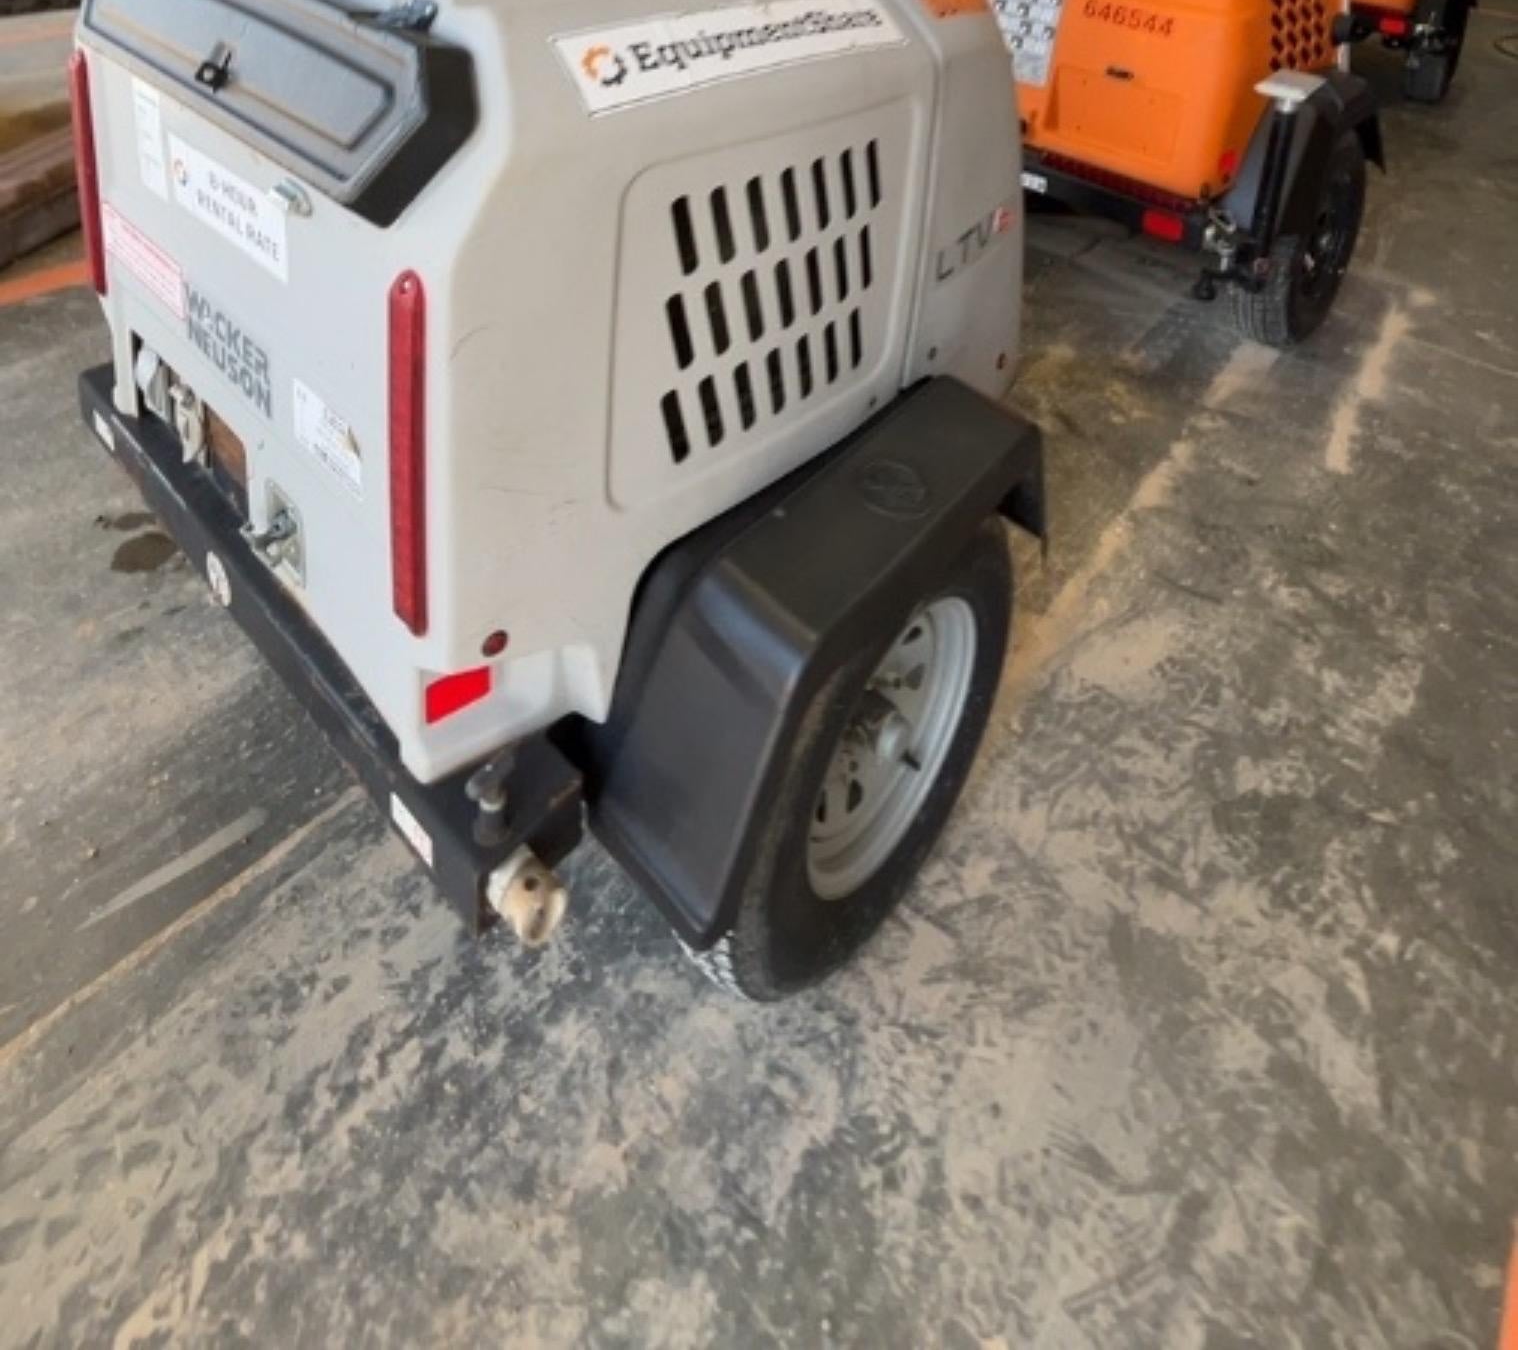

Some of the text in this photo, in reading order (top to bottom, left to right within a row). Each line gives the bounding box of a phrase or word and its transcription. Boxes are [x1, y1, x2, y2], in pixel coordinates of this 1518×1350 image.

[628, 9, 884, 72] EquipmentShare
[245, 222, 281, 264] RATE
[189, 314, 272, 420] NEUSON
